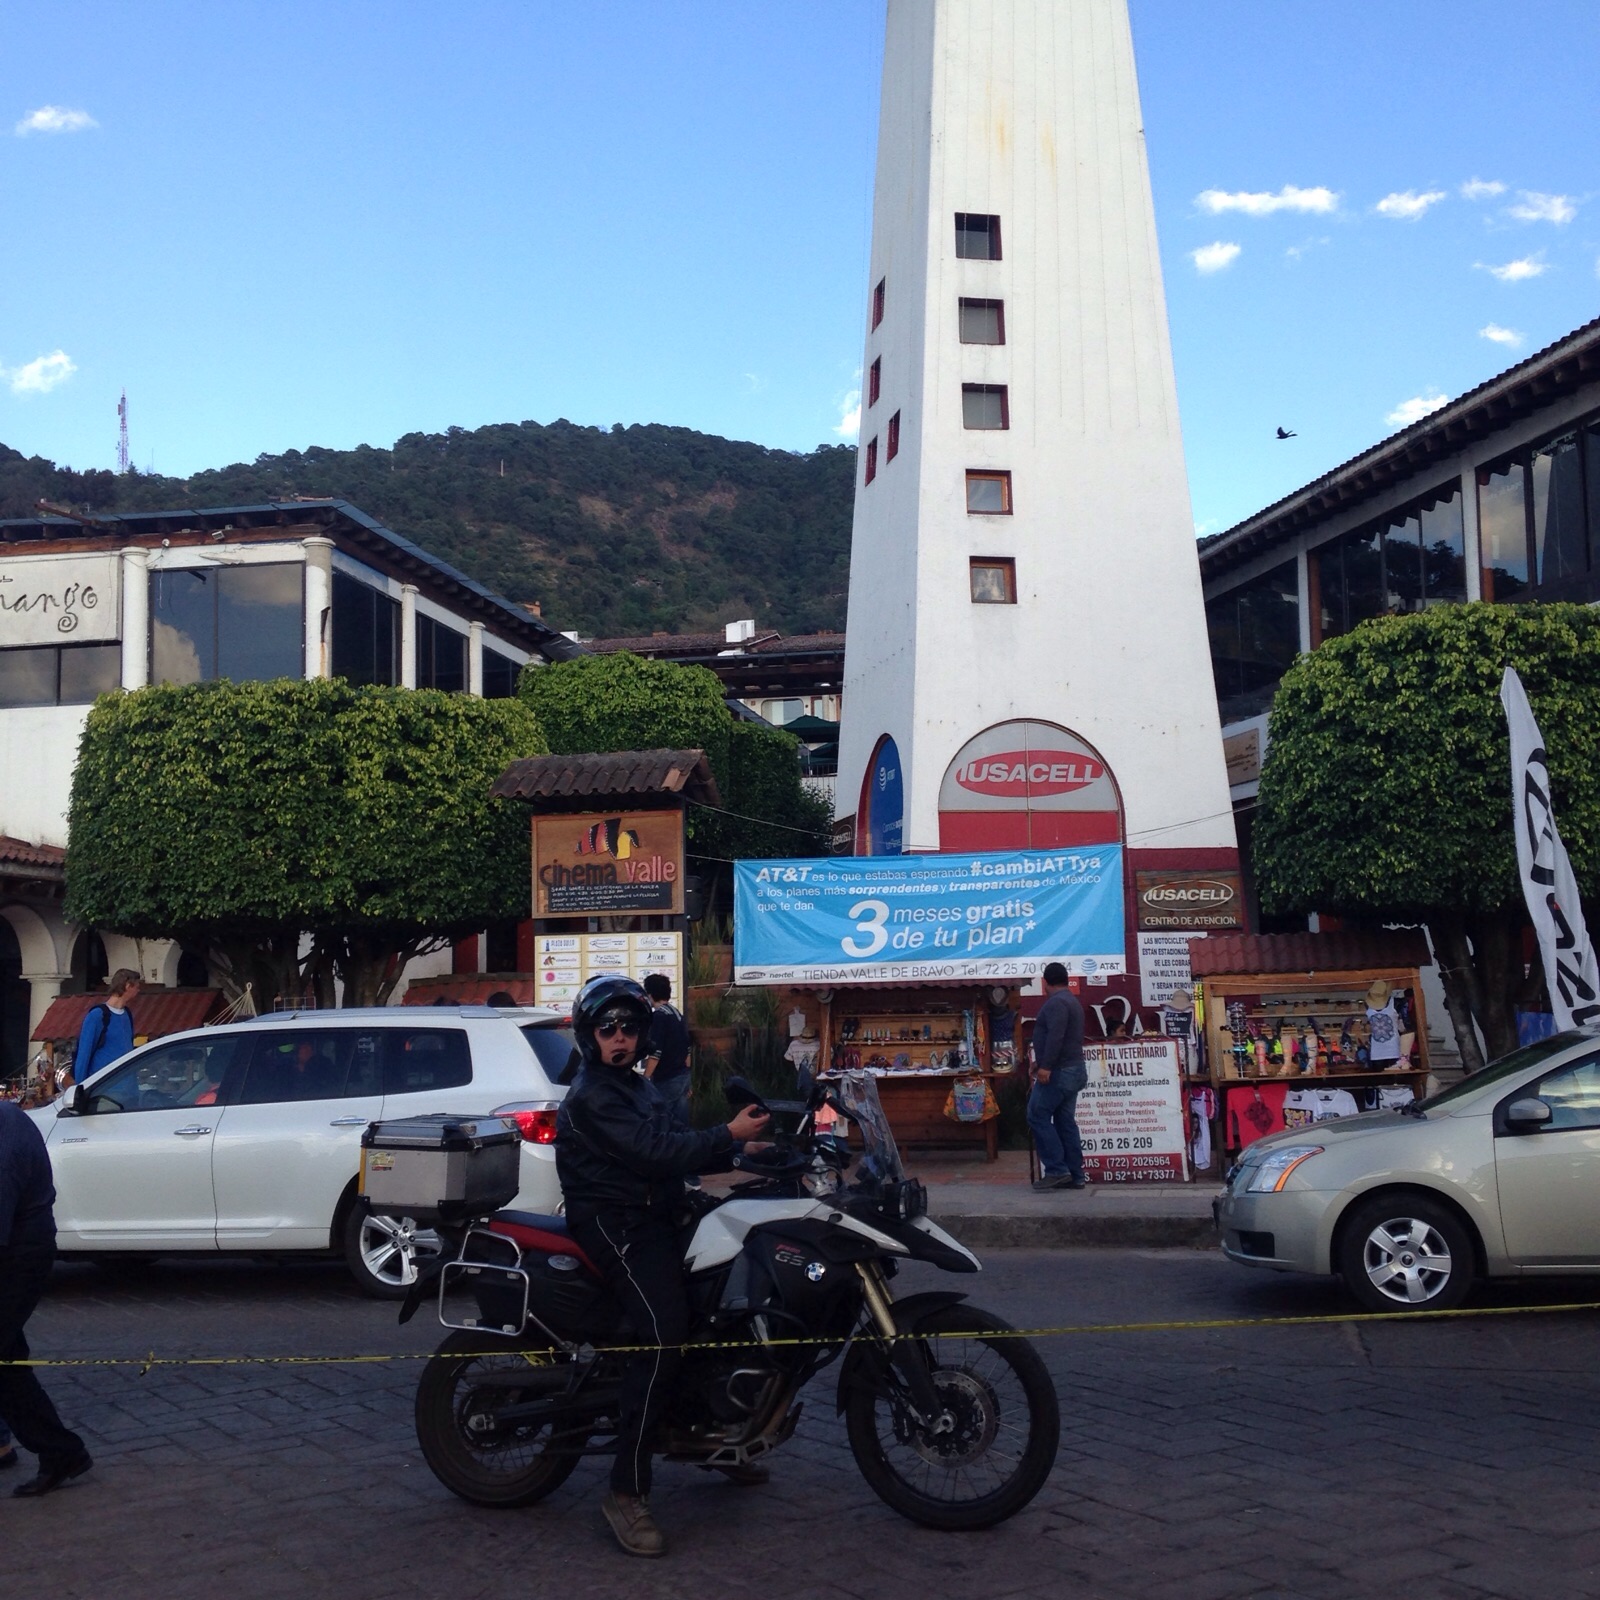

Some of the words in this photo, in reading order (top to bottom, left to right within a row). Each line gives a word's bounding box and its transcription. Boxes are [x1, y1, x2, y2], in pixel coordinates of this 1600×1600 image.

[0, 583, 98, 633] ango
[959, 762, 1103, 783] IUSACELL
[539, 859, 618, 886] cinema
[624, 855, 677, 884] valle
[756, 867, 813, 883] AT&T
[812, 873, 825, 882] es
[828, 872, 837, 881] lo
[841, 872, 861, 885] que
[865, 868, 907, 882] estabas
[910, 866, 968, 884] esperando
[757, 889, 764, 898] a
[767, 887, 783, 897] los
[787, 885, 820, 900] planes
[825, 883, 847, 896] más
[848, 880, 939, 897] sorprendentes
[941, 883, 947, 894] y
[950, 876, 1041, 892] transparentes
[1042, 877, 1056, 886] de
[1060, 873, 1101, 885] México
[1147, 888, 1231, 901] IUSACELL
[758, 902, 777, 913] que
[780, 901, 791, 911] te
[795, 901, 814, 911] dan
[893, 907, 962, 923] meses
[966, 900, 1035, 924] gratis
[1144, 916, 1179, 926] CENTRO
[1181, 916, 1193, 925] DE
[1193, 916, 1237, 925] ATENCION
[841, 899, 890, 958] 3
[892, 926, 924, 949] de
[933, 927, 958, 947] tu
[1143, 937, 1153, 945] LAS
[1154, 937, 1190, 945] MOTOCICLETA
[1158, 948, 1190, 956] ESTACIONADA
[1100, 962, 1121, 971] AT&T
[1154, 959, 1162, 967] SE
[1162, 959, 1171, 967] LES
[802, 969, 847, 981] TIENDA
[849, 968, 888, 980] VALLE
[891, 967, 908, 978] DE
[912, 965, 955, 977] BRAVO
[961, 965, 981, 976] Tel.
[985, 964, 999, 975] 72
[1004, 963, 1018, 975] 25
[1022, 962, 1037, 974] 70
[1159, 970, 1176, 978] MULTA
[1118, 1045, 1167, 1060] VETERINARIO
[1108, 1062, 1143, 1077] VALLE
[1098, 1082, 1102, 1090] y
[1128, 1077, 1170, 1088] especializada
[1081, 1091, 1095, 1100] para
[1097, 1090, 1104, 1098] tu
[1105, 1089, 1132, 1098] mascota
[1125, 1108, 1155, 1116] Preventiva
[1106, 1126, 1130, 1134] Alimento
[1101, 1138, 1114, 1150] 26
[1117, 1138, 1130, 1149] 26
[1133, 1136, 1153, 1149] 209
[1106, 1156, 1129, 1170] (722)
[1132, 1156, 1170, 1168] 2026964
[1103, 1170, 1113, 1181] ID
